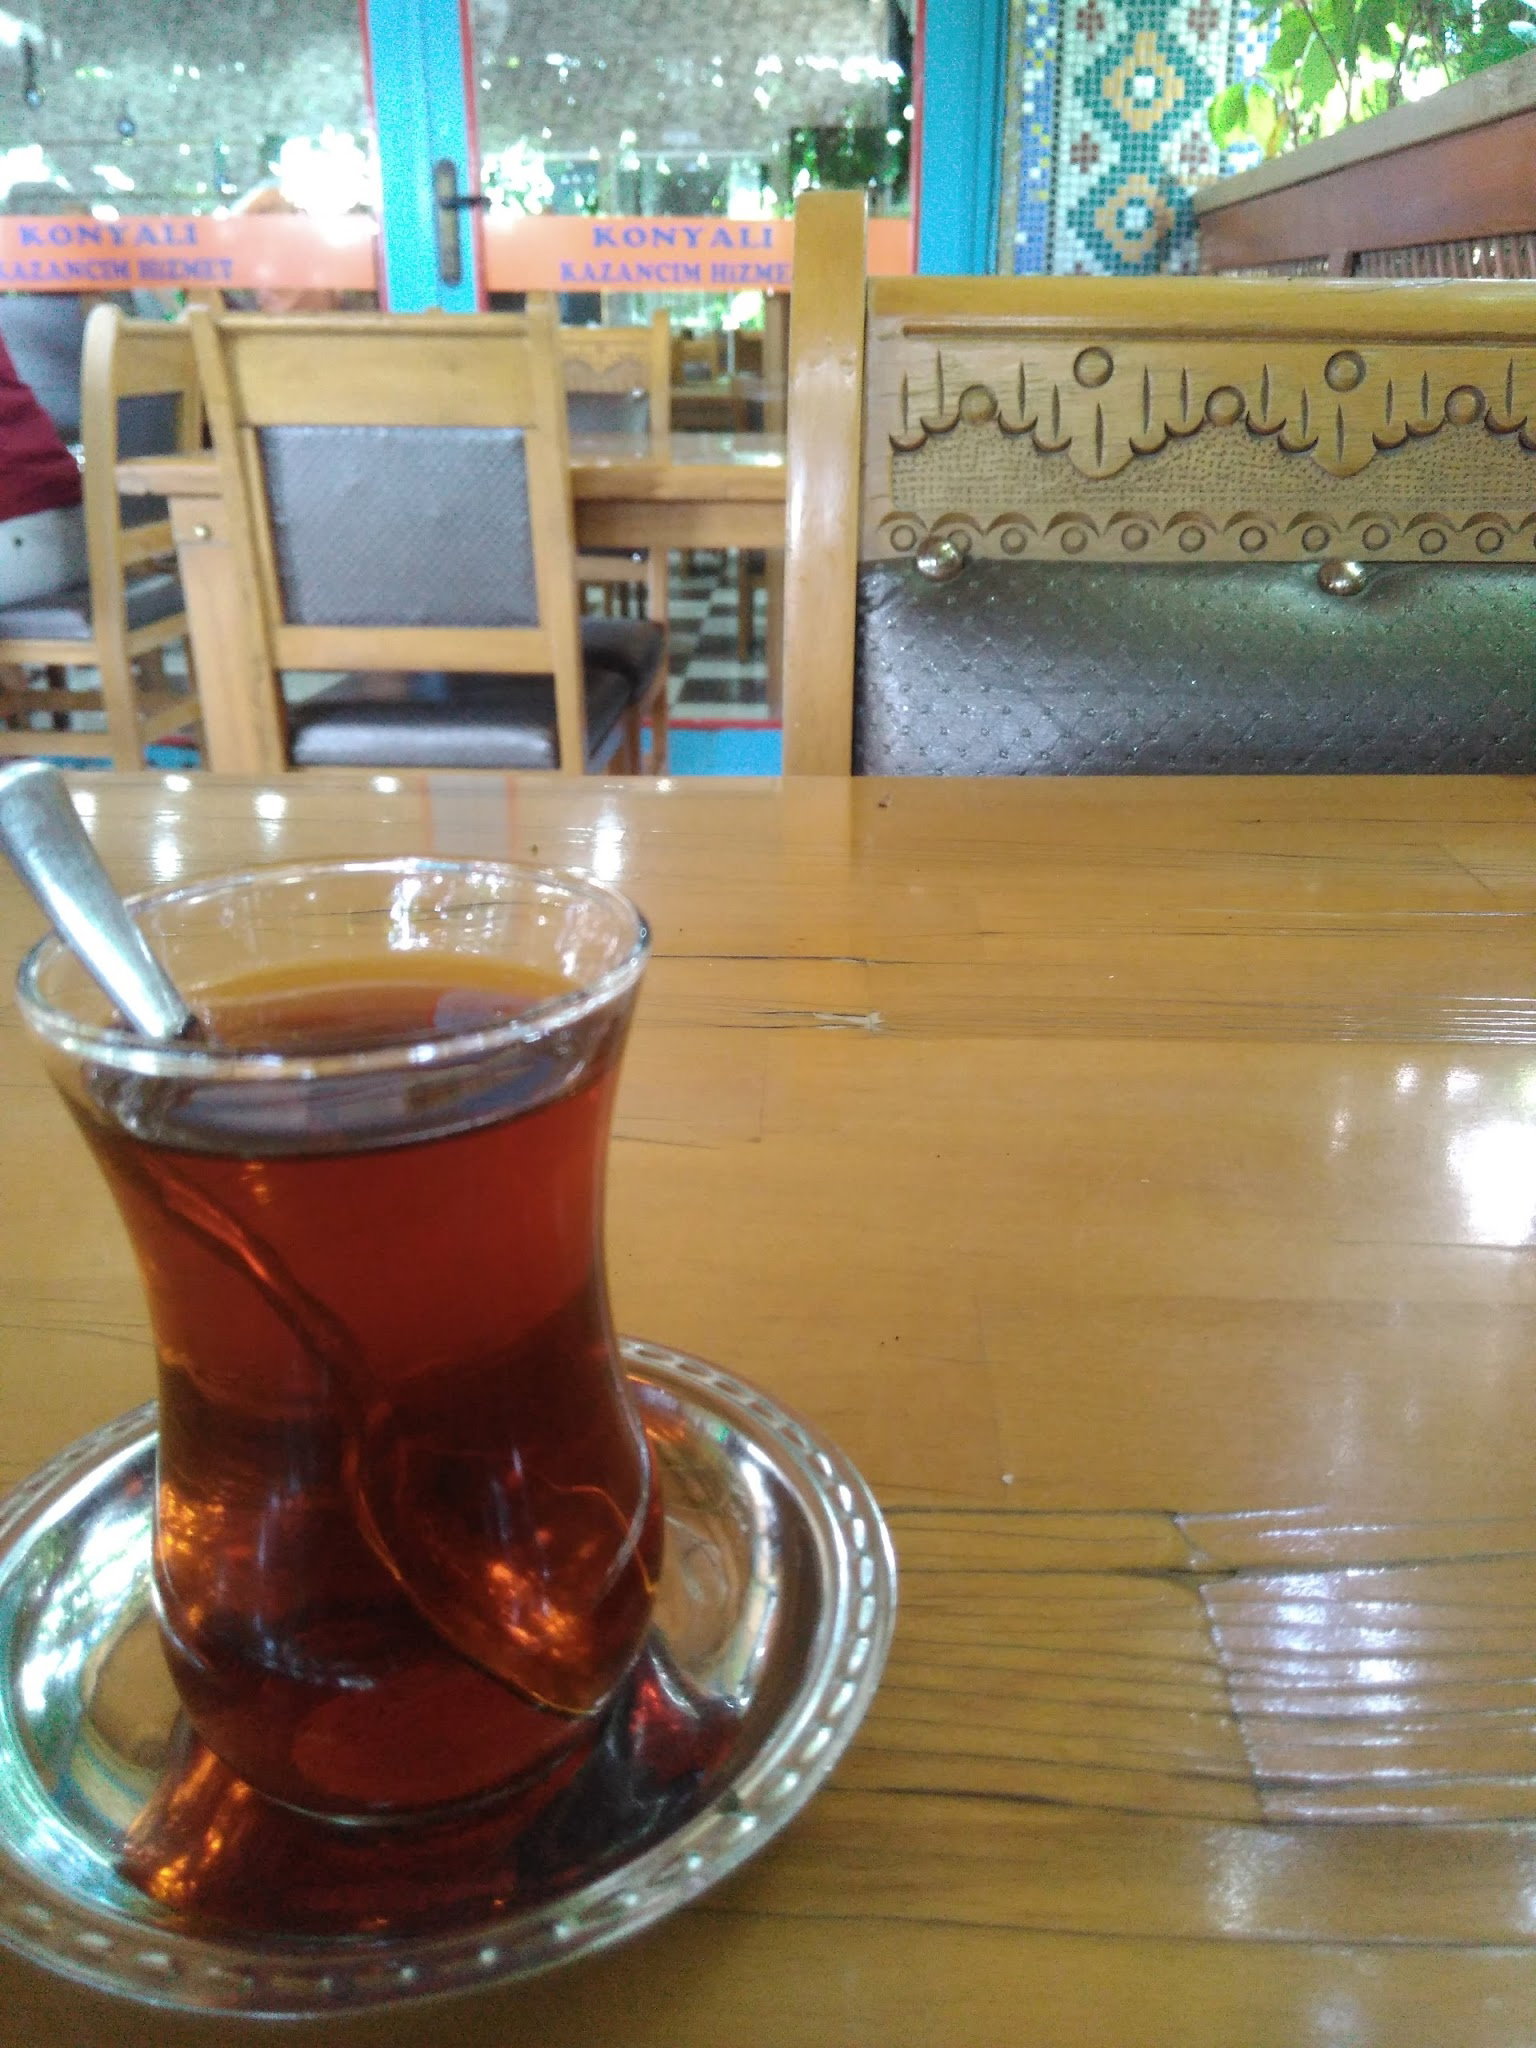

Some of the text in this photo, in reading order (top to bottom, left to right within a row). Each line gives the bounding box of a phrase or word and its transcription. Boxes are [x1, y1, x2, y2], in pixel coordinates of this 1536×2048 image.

[20, 223, 197, 246] KONYALI
[592, 226, 773, 249] KONYALI
[560, 262, 701, 283] KAZANCIM
